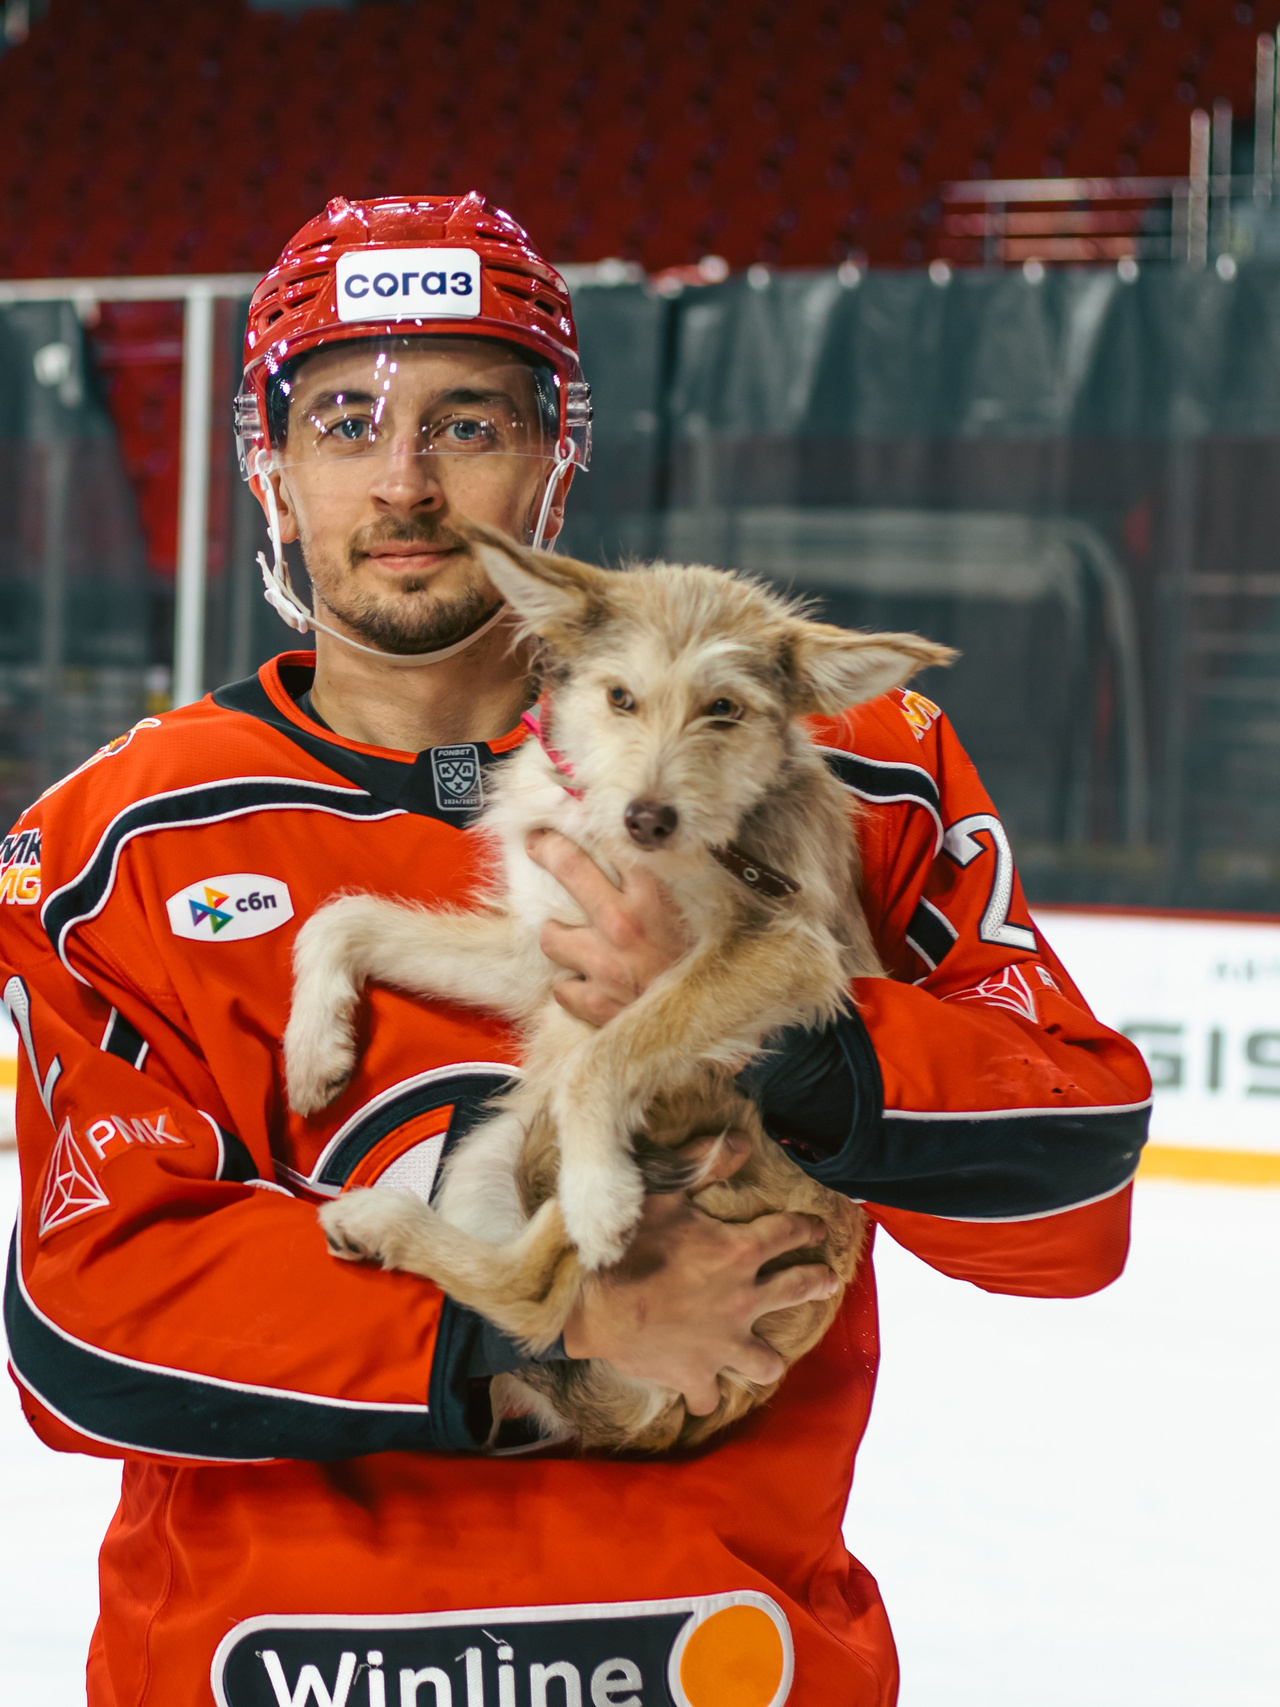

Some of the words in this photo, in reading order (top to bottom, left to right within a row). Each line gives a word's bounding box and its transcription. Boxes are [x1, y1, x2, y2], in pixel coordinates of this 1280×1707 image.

[344, 270, 473, 299] согаз
[437, 748, 471, 757] FONBET
[235, 891, 277, 912] сбп
[259, 1644, 644, 1707] Winline
